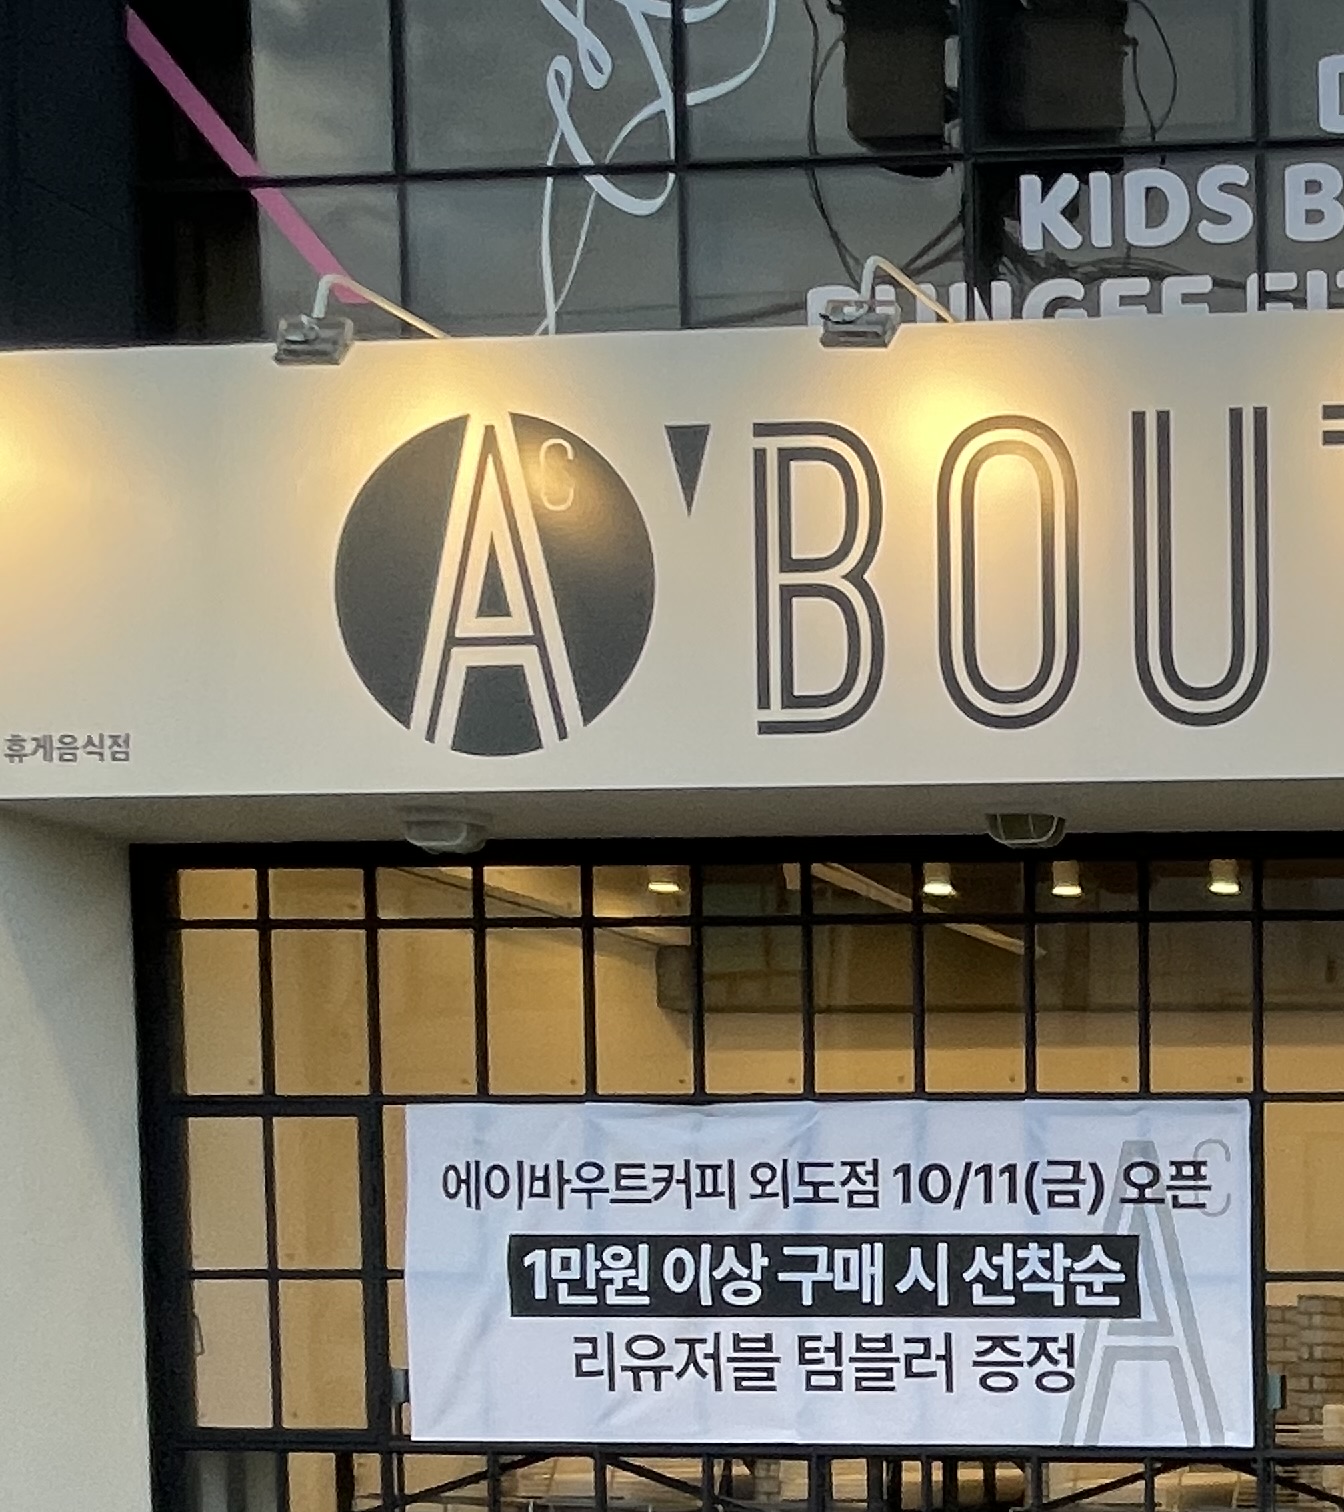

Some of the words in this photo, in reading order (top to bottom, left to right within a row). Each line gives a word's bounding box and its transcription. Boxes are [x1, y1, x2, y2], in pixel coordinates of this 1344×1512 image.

[1019, 165, 1255, 251] KIDS
[3, 732, 131, 764] 휴게음식점
[441, 1159, 737, 1210] 에이바우트커피
[749, 1158, 880, 1209] 외도점
[892, 1160, 1106, 1215] 10/11(금)
[1119, 1159, 1212, 1209] 오픈
[522, 1243, 651, 1306] 1만원
[662, 1243, 769, 1306] 이상
[777, 1242, 886, 1306] 구매
[895, 1242, 949, 1306] 시
[962, 1242, 1126, 1307] 선착순
[572, 1331, 782, 1392] 리유저블
[797, 1332, 955, 1393] 텀블러
[972, 1332, 1077, 1393] 증정
